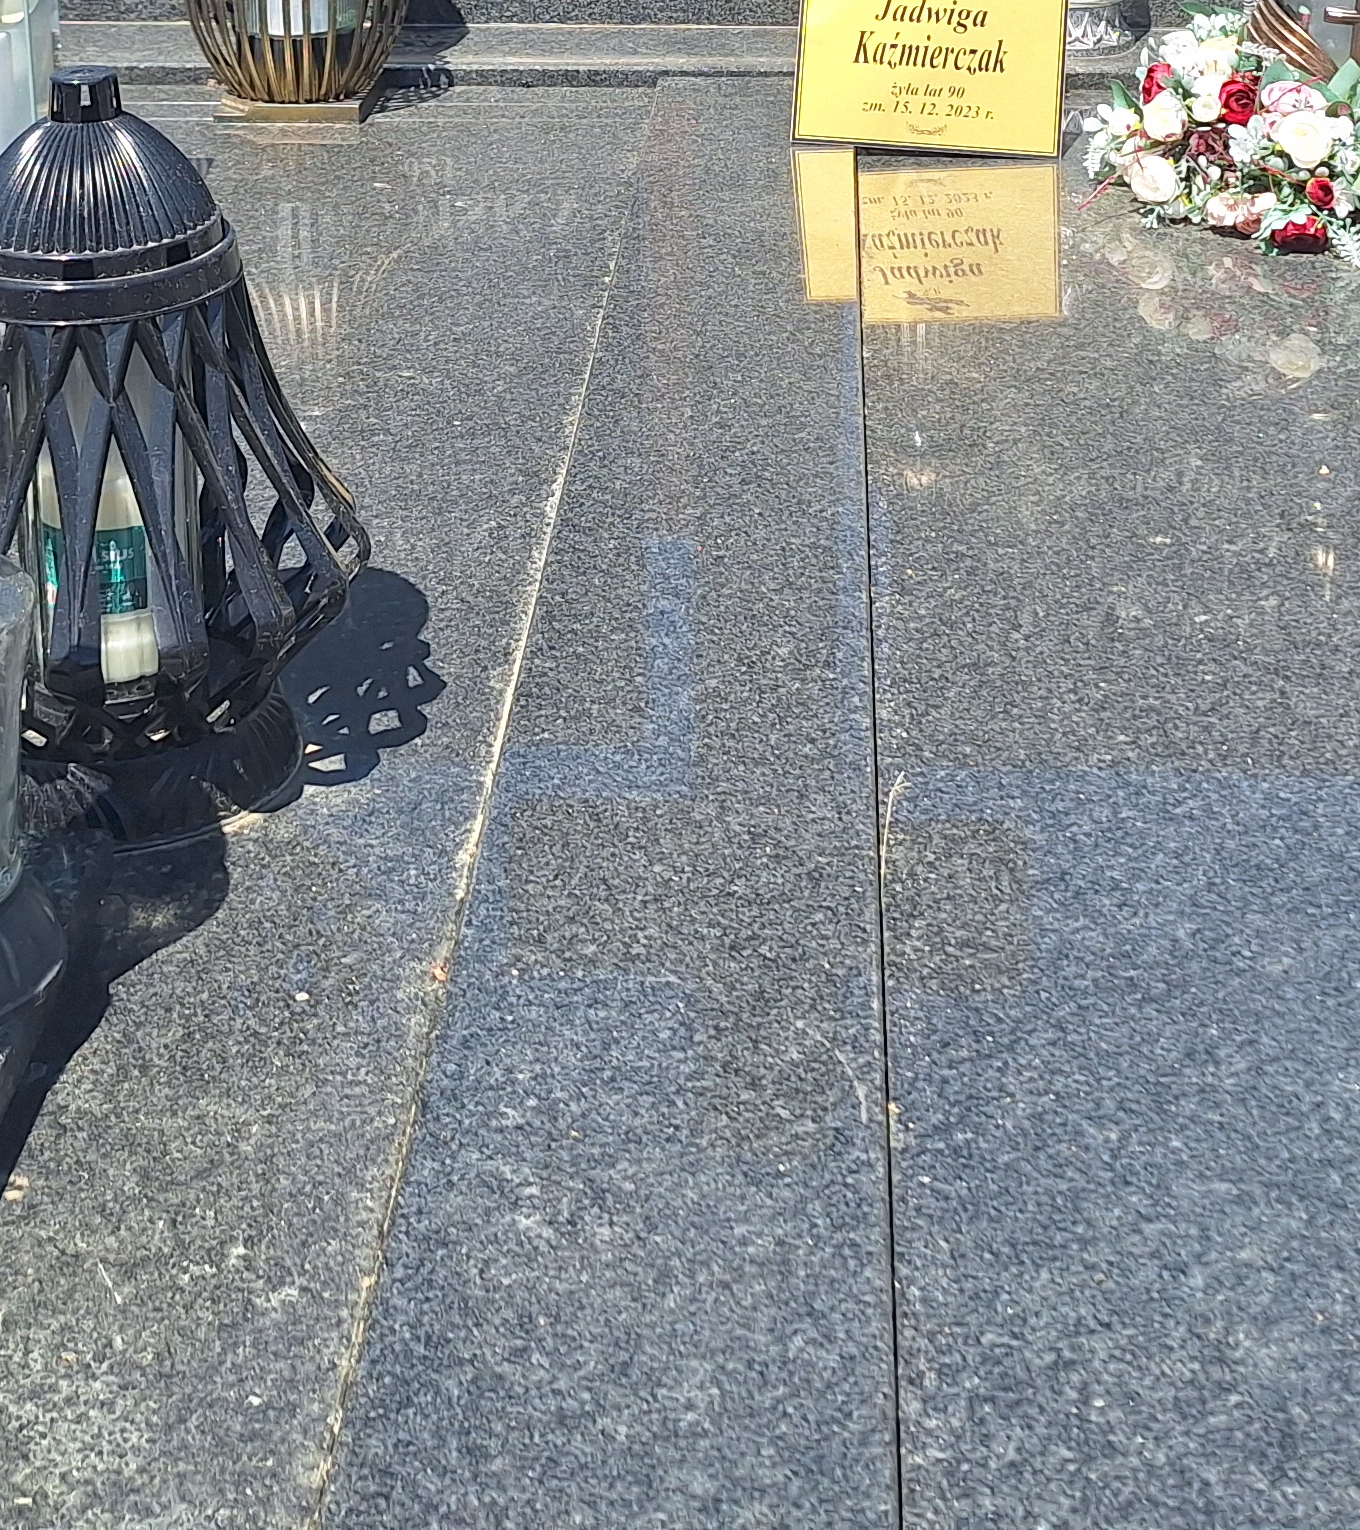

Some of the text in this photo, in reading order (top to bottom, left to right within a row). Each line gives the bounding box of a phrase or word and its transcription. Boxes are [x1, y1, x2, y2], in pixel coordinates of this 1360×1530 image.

[852, 29, 1009, 75] Kaźmierczak
[923, 84, 943, 98] lat
[947, 85, 965, 99] 90
[862, 100, 994, 120] zm. 15. 12. 2023 r.
